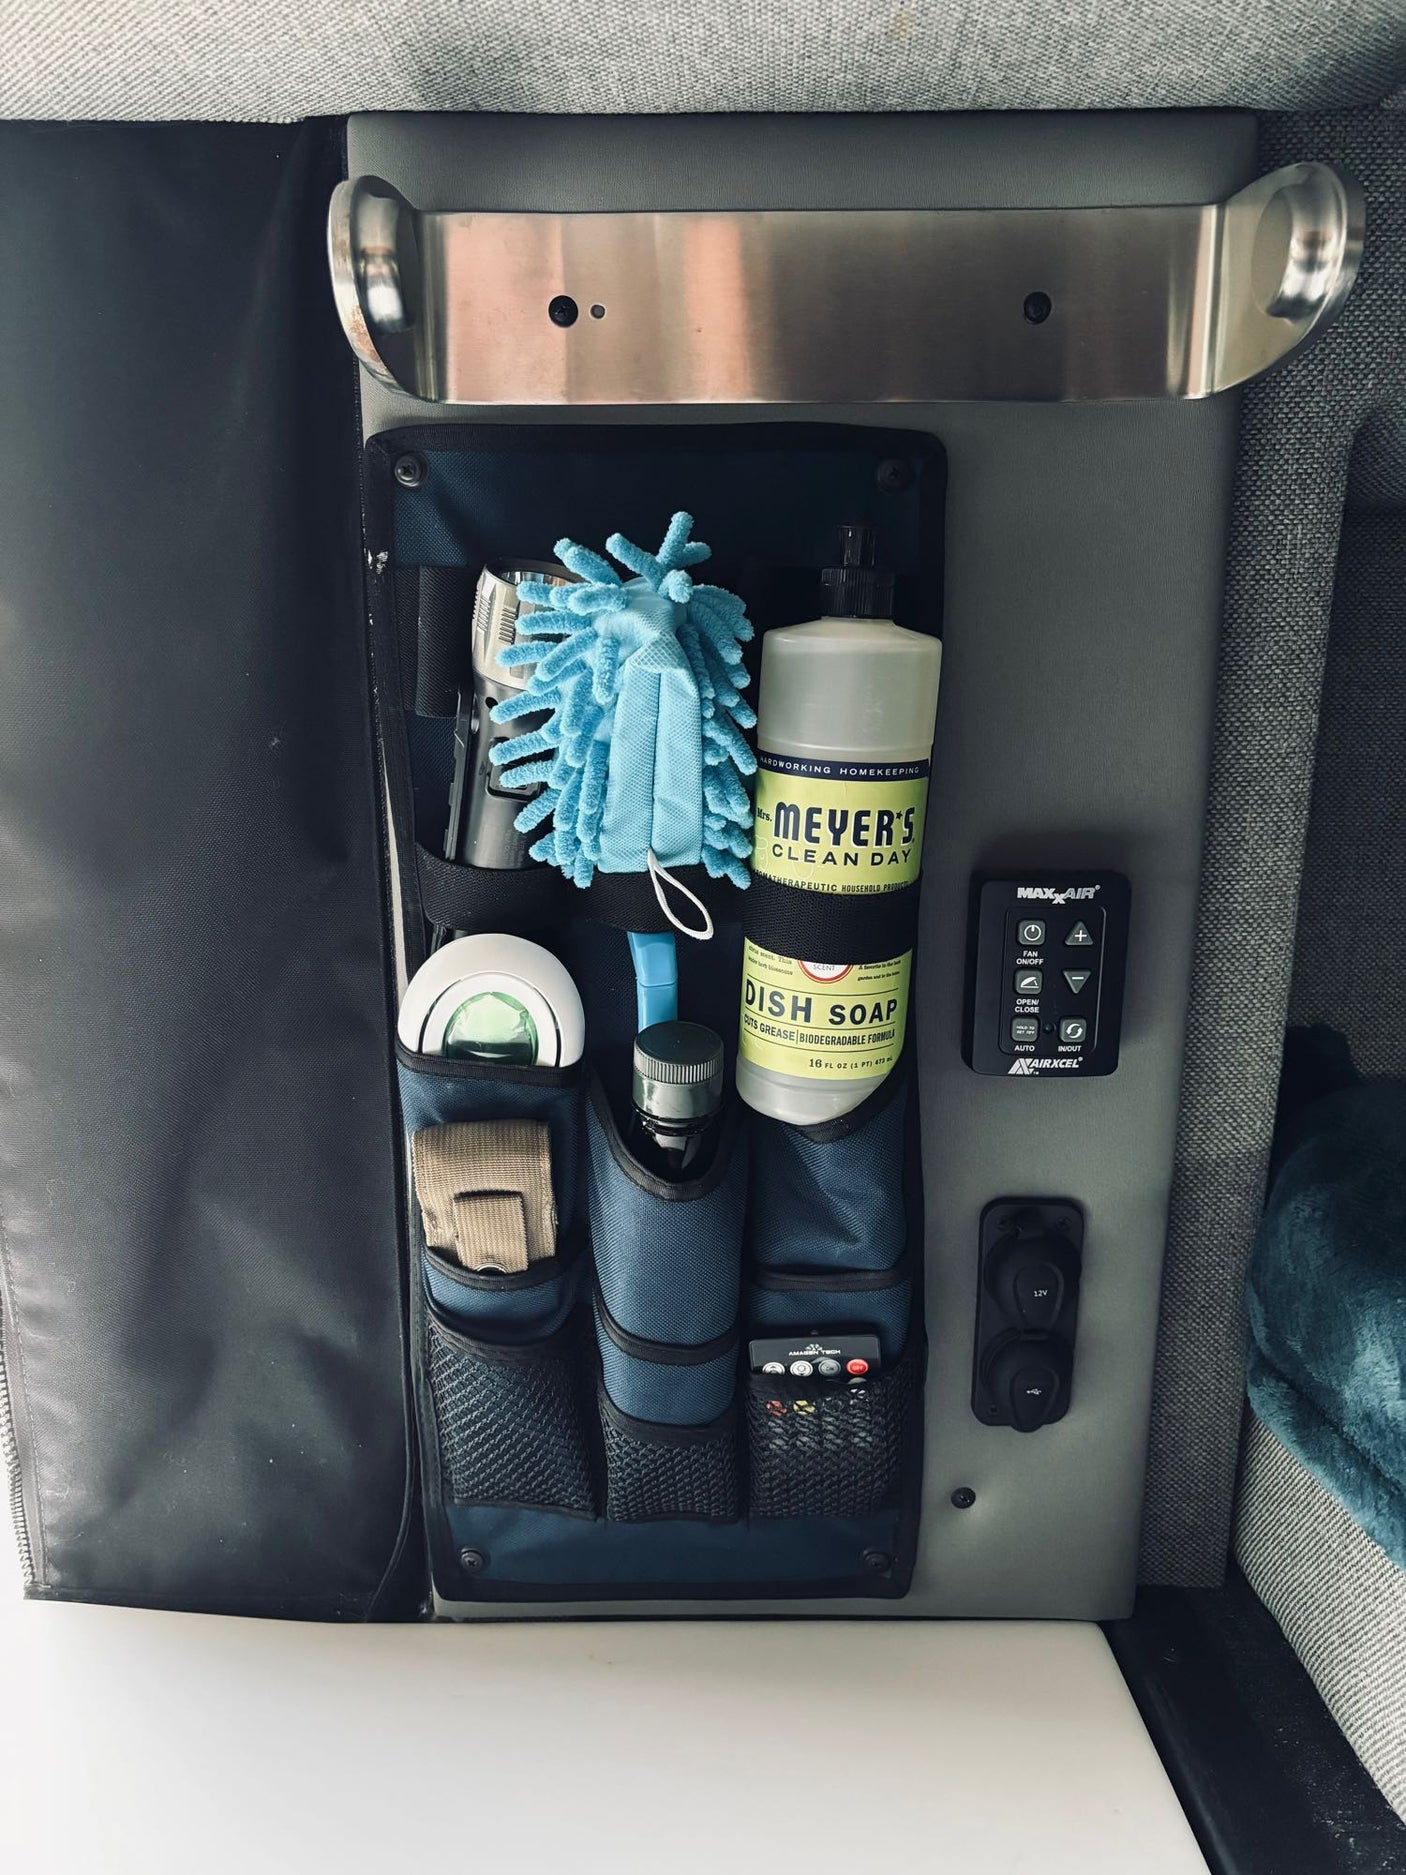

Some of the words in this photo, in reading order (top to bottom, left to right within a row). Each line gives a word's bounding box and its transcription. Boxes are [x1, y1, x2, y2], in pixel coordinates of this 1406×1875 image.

[840, 767, 919, 776] HOMEKEEPING
[757, 807, 773, 822] Mrs.
[772, 843, 859, 866] CLEAN
[870, 850, 911, 867] DAY
[841, 884, 881, 893] HOUSEHOLD
[1023, 950, 1039, 958] FAN
[1016, 958, 1044, 966] ON/OFF
[744, 978, 813, 1024] DISH
[828, 998, 898, 1026] SOAP
[1016, 998, 1040, 1006] OPEN/
[744, 1013, 759, 1030] CUTS
[759, 1024, 796, 1042] GREASE
[799, 1032, 866, 1046] BIODEGRADABLE
[867, 1028, 896, 1044] FORMULA
[809, 1058, 823, 1069] 16
[861, 1060, 873, 1068] PT)
[1029, 1059, 1080, 1069] AIRXCEL
[1033, 1289, 1048, 1297] 12V
